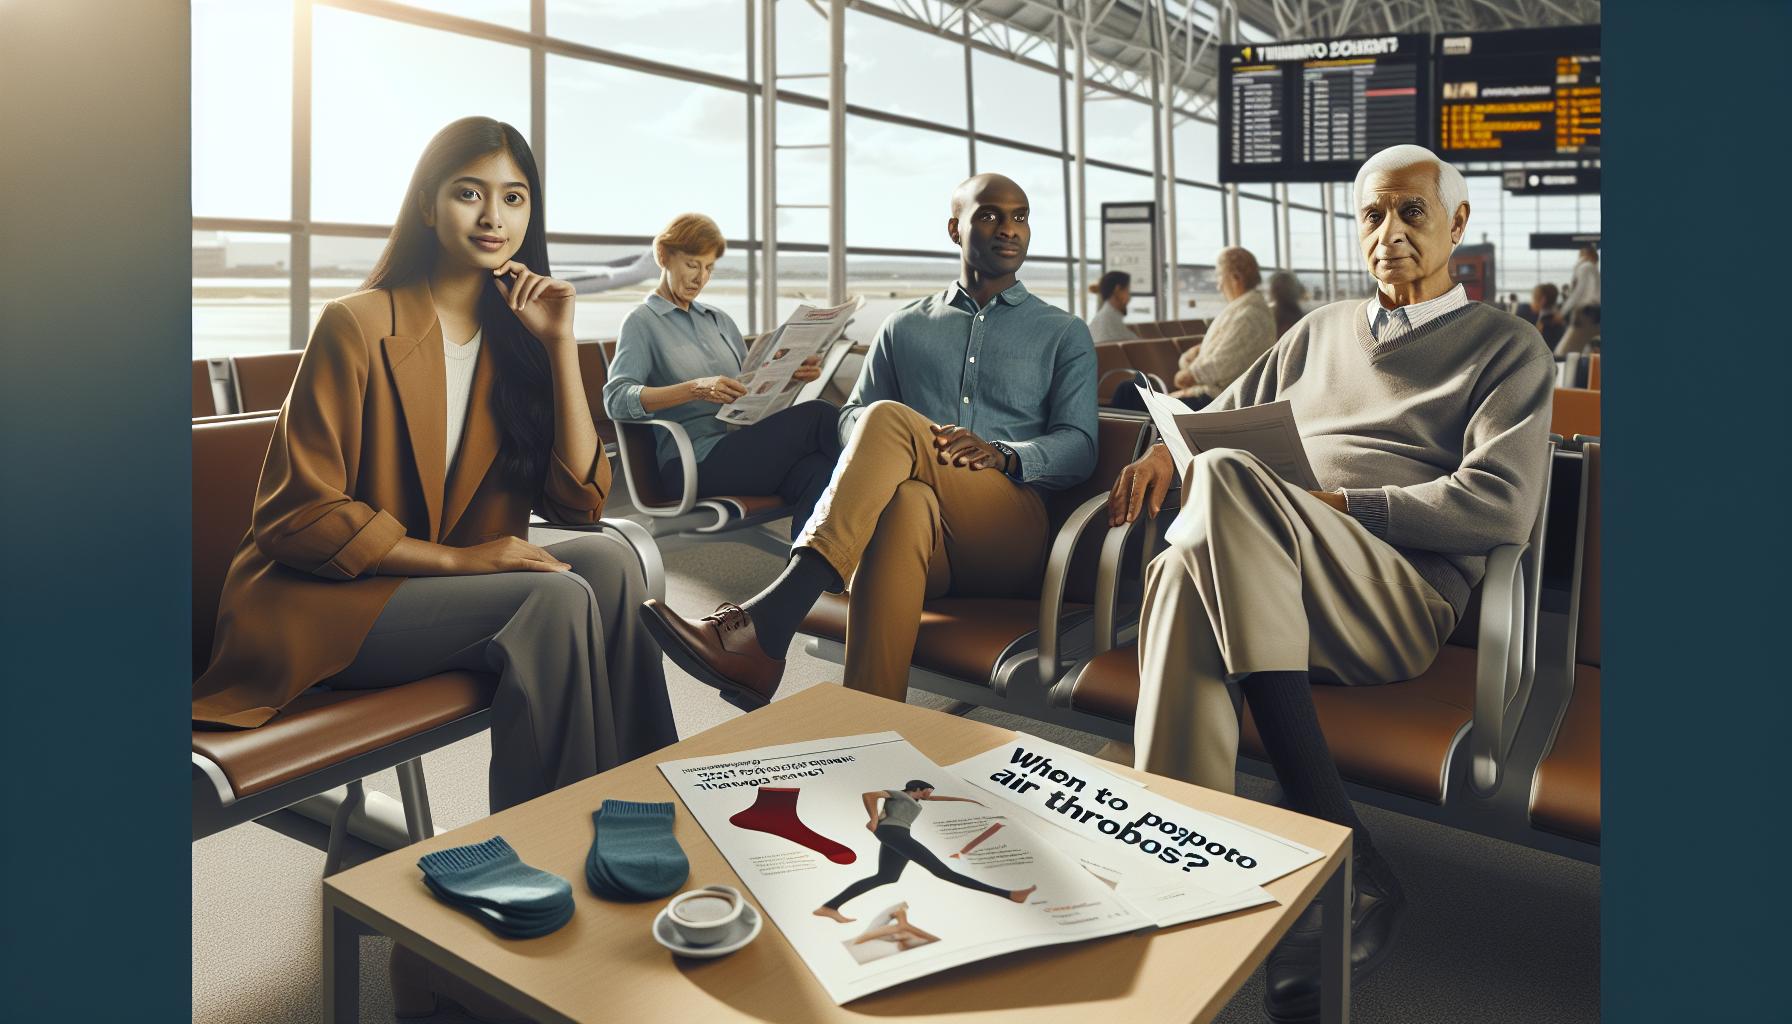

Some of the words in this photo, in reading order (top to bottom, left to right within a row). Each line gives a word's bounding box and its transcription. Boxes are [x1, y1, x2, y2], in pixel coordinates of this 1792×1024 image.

[989, 768, 1041, 794] air
[1044, 790, 1210, 873] throbos?
[1094, 788, 1129, 811] to
